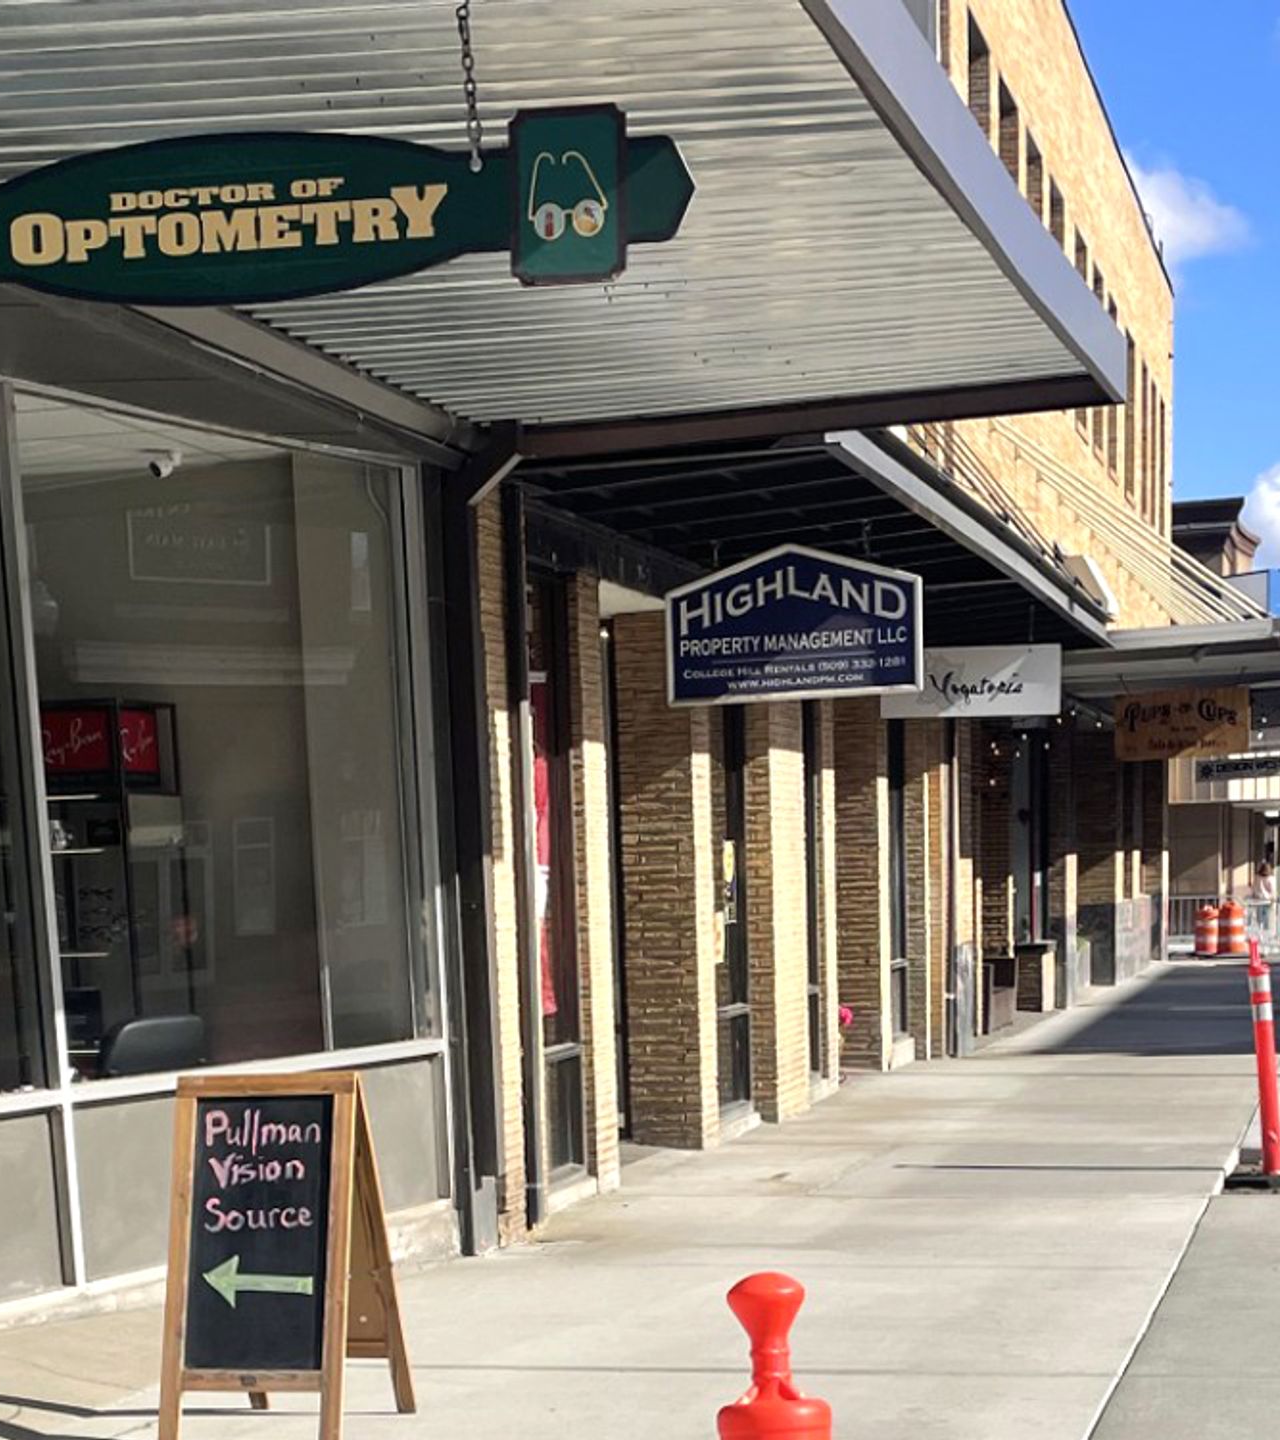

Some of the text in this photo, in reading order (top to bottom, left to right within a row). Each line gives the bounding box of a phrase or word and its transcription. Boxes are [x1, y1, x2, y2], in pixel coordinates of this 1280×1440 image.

[110, 177, 345, 212] DOCTOR OF
[10, 183, 449, 266] OPTOMETRY
[679, 565, 908, 637] HIGHLAND
[680, 625, 908, 658] PROPERTY MANAGEMENT LLC
[683, 667, 734, 679] COLLEGE
[737, 664, 762, 677] HILL
[764, 662, 815, 676] RENTALS
[205, 1109, 320, 1156] Pullman
[208, 1152, 306, 1189] Vision
[204, 1197, 314, 1233] Source
